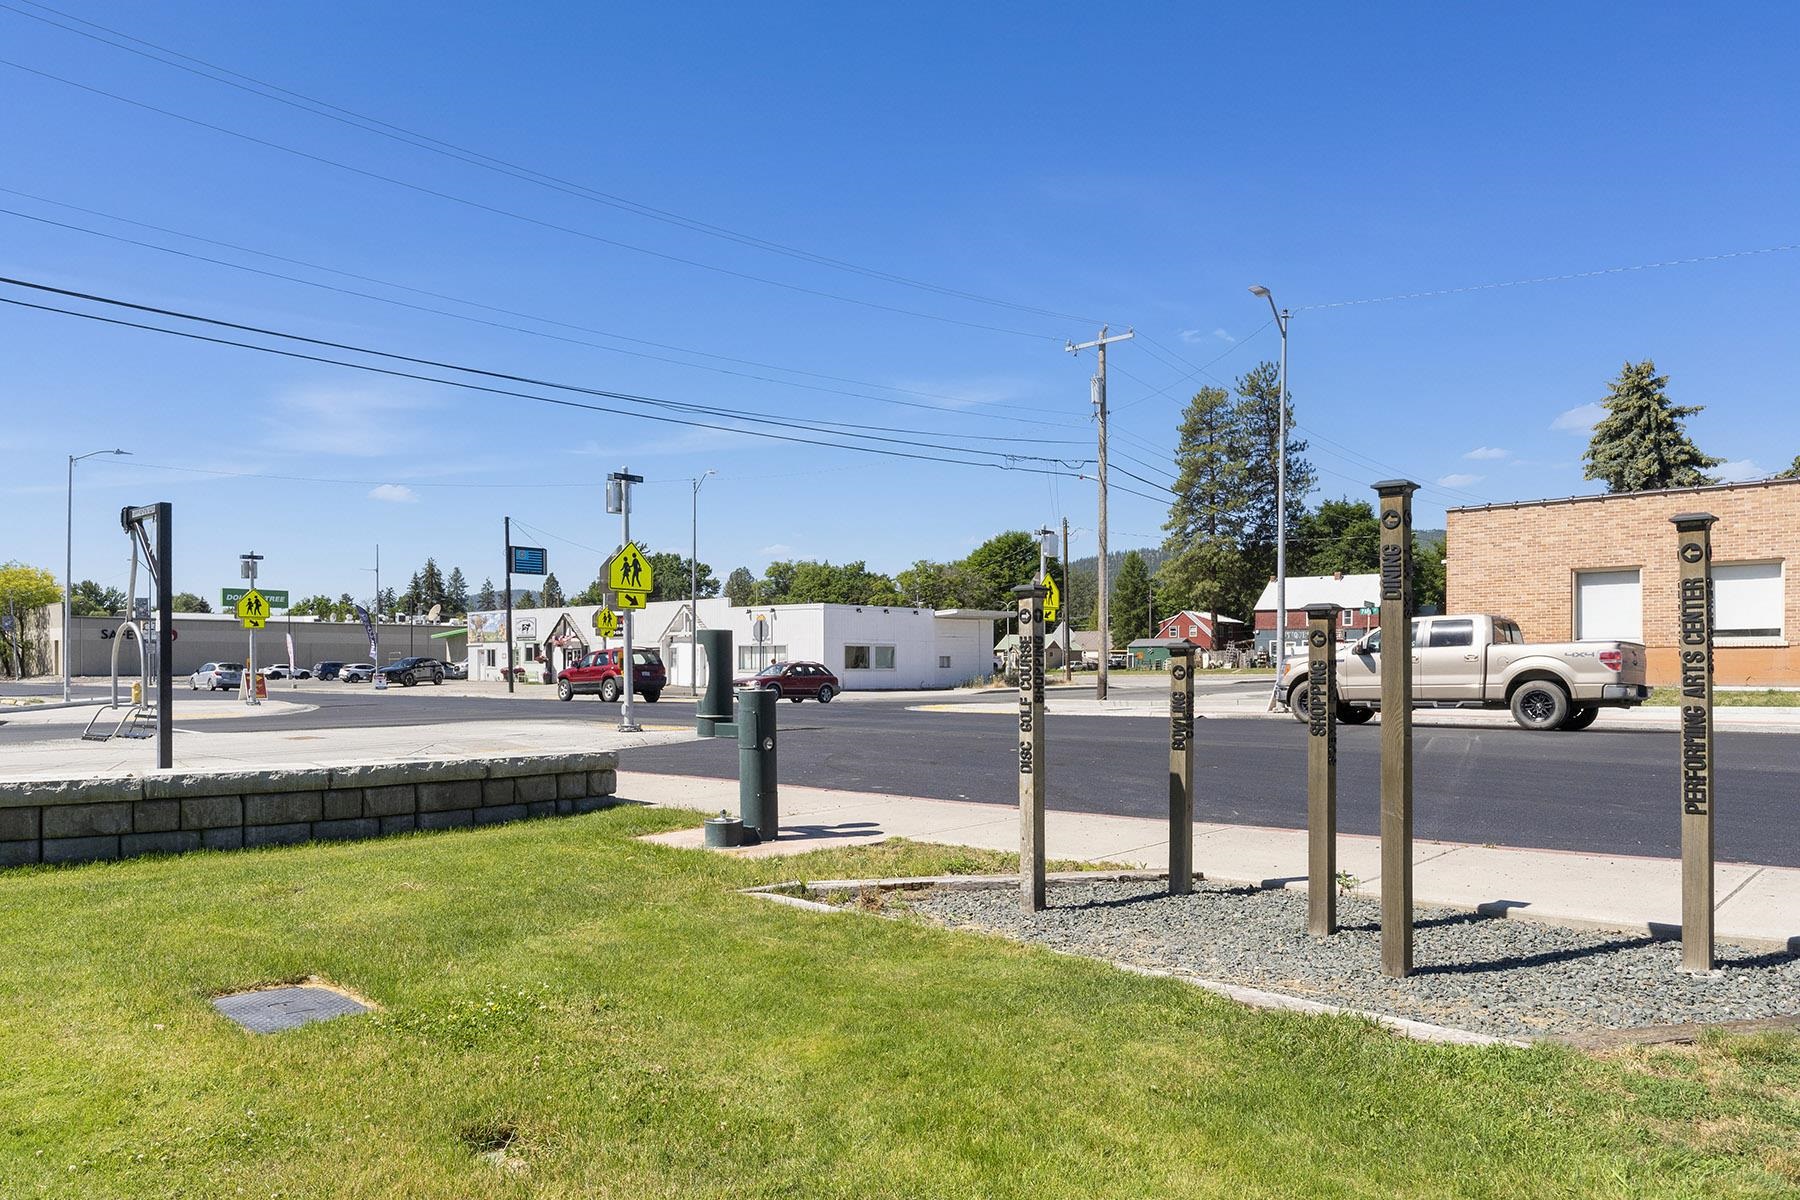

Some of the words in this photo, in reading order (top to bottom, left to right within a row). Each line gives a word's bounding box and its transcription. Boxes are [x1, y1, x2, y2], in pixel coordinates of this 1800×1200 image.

[1382, 544, 1402, 600] DINING
[1681, 577, 1705, 646] CENTER
[1020, 635, 1032, 691] COURSE
[1033, 635, 1044, 704] SHOPPING
[1683, 650, 1706, 699] ARTS
[1020, 697, 1032, 733] GOLF
[1172, 691, 1186, 751] BOWLING
[1310, 660, 1327, 737] SHOPPING
[1020, 741, 1032, 774] DISC
[1683, 705, 1707, 816] PERFORMING
